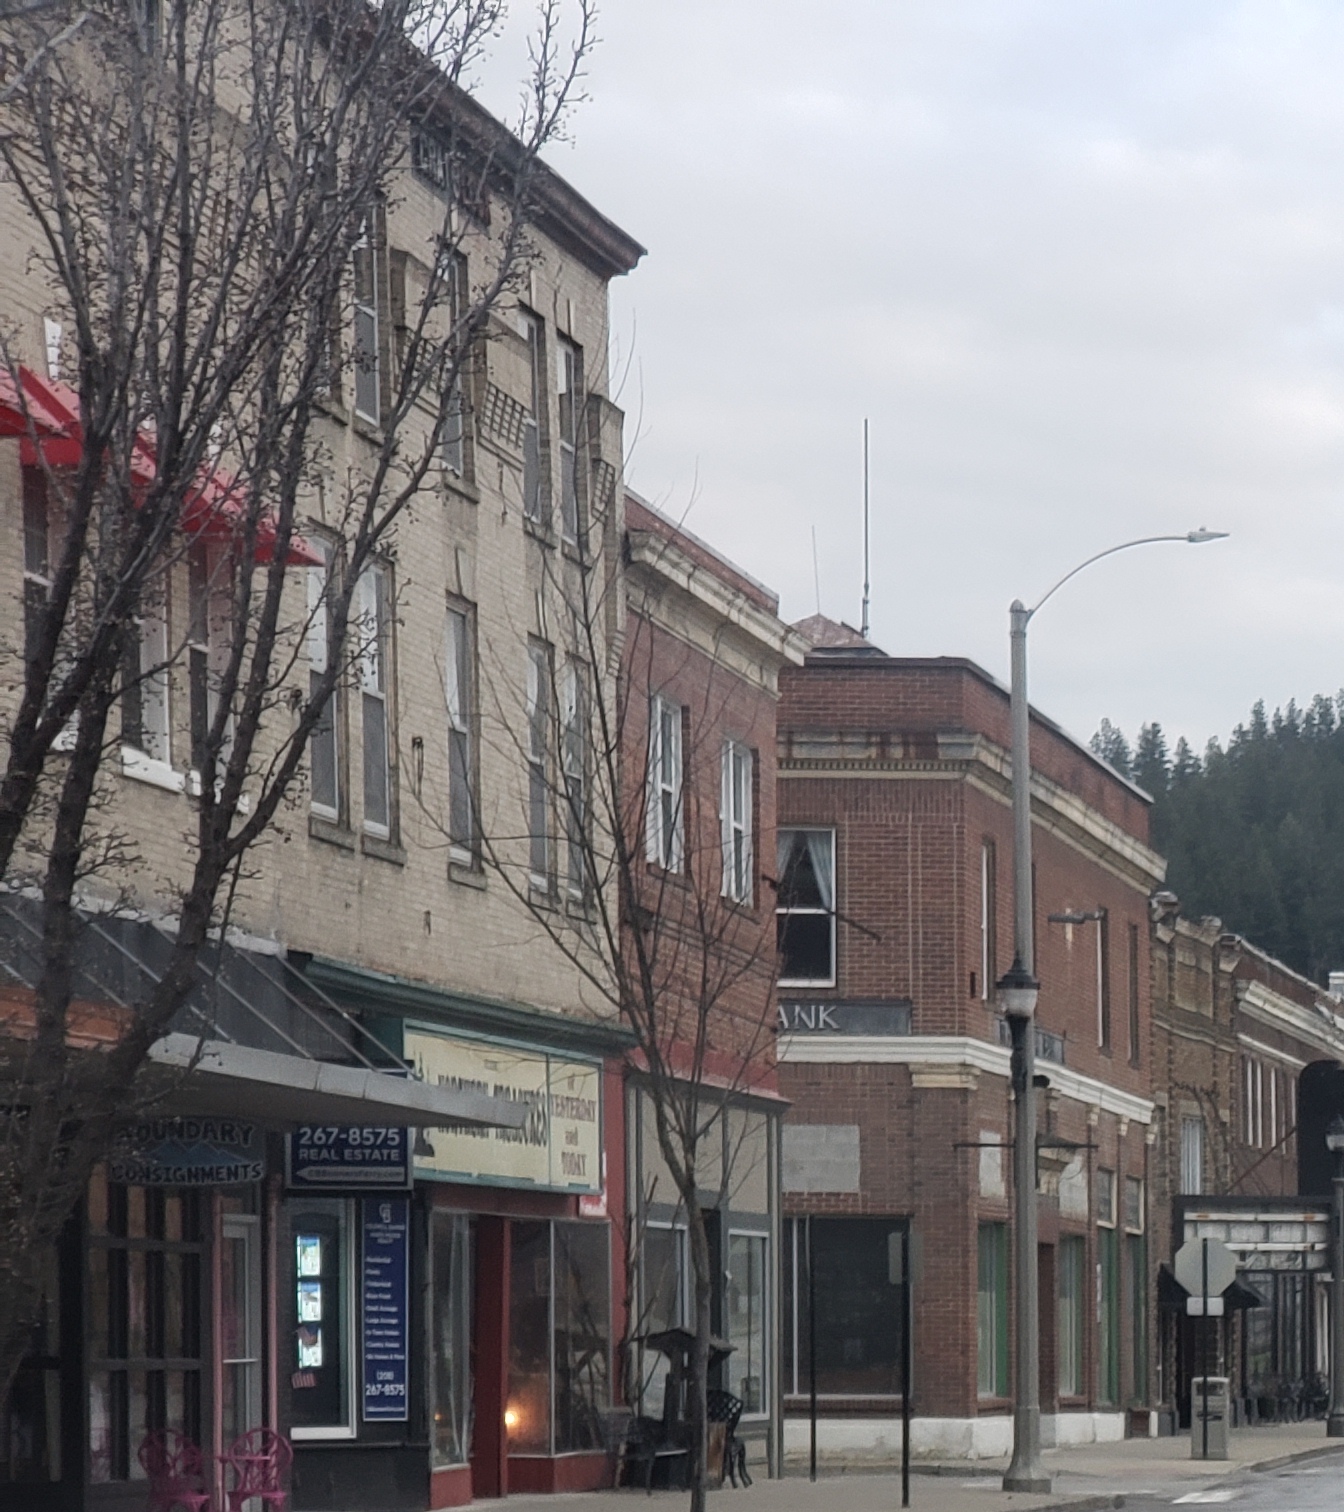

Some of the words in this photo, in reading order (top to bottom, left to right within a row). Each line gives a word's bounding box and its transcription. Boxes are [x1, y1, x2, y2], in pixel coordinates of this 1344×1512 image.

[299, 1127, 401, 1146] 267-8575
[299, 1149, 340, 1160] REAL
[344, 1149, 400, 1161] ESTATE
